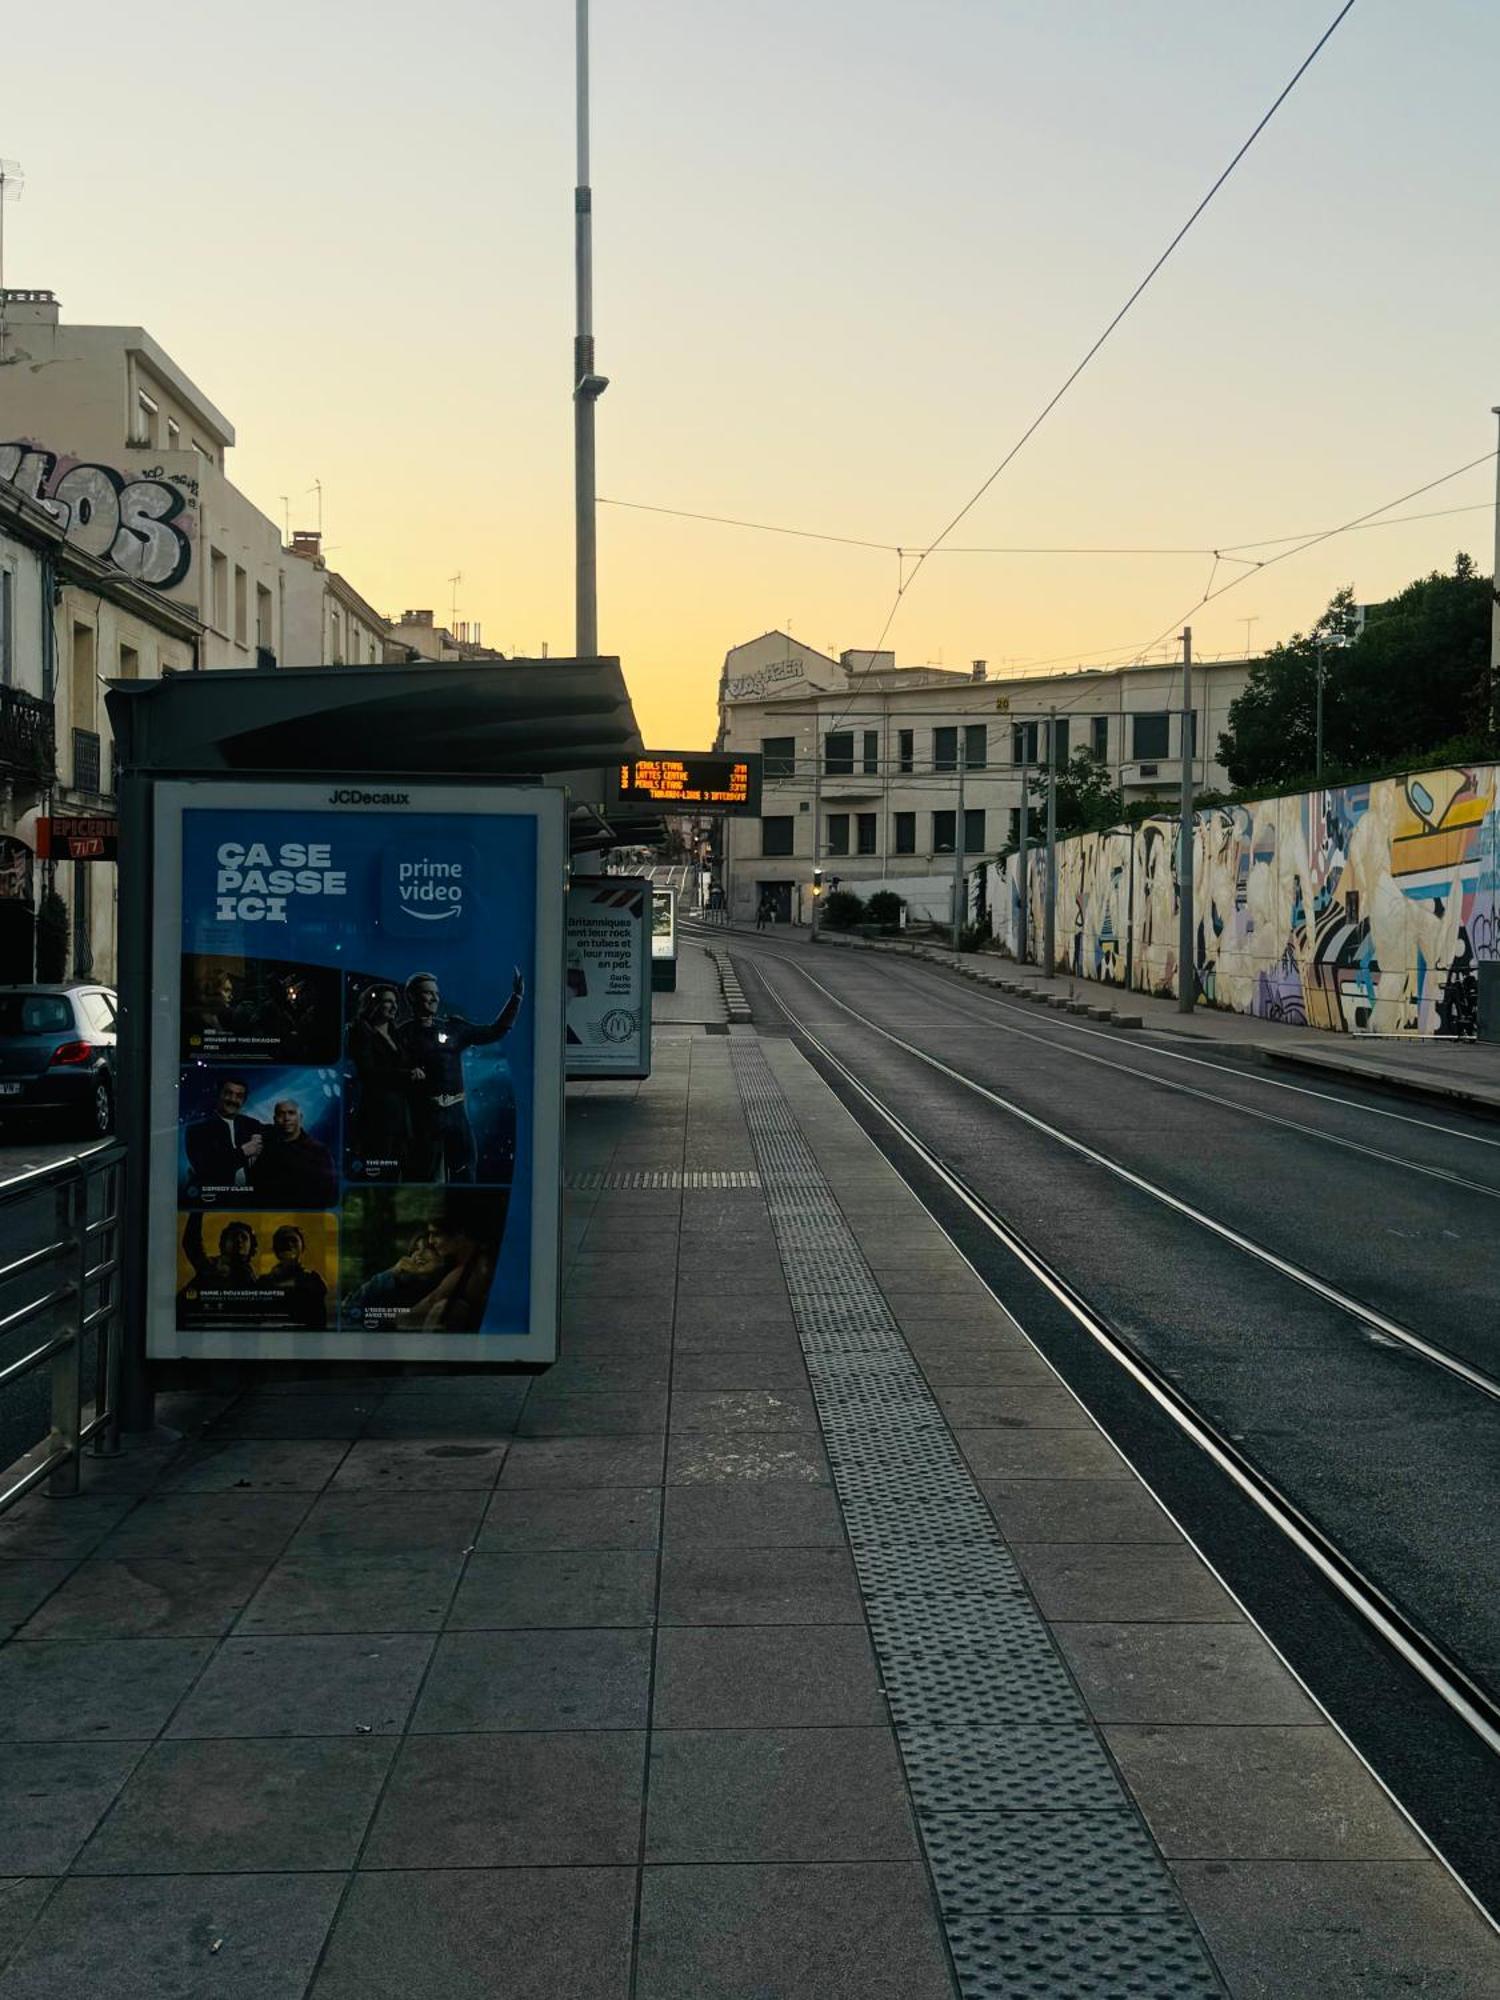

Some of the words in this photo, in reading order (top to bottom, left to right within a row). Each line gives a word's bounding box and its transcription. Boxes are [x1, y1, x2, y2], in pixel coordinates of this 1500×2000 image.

[329, 790, 410, 806] JCDecaux
[217, 843, 272, 870] ÇA
[280, 844, 331, 868] SE
[399, 858, 462, 880] prime
[217, 870, 346, 895] PASSE
[399, 880, 462, 902] video
[216, 897, 287, 921] ICI
[609, 929, 632, 937] rock
